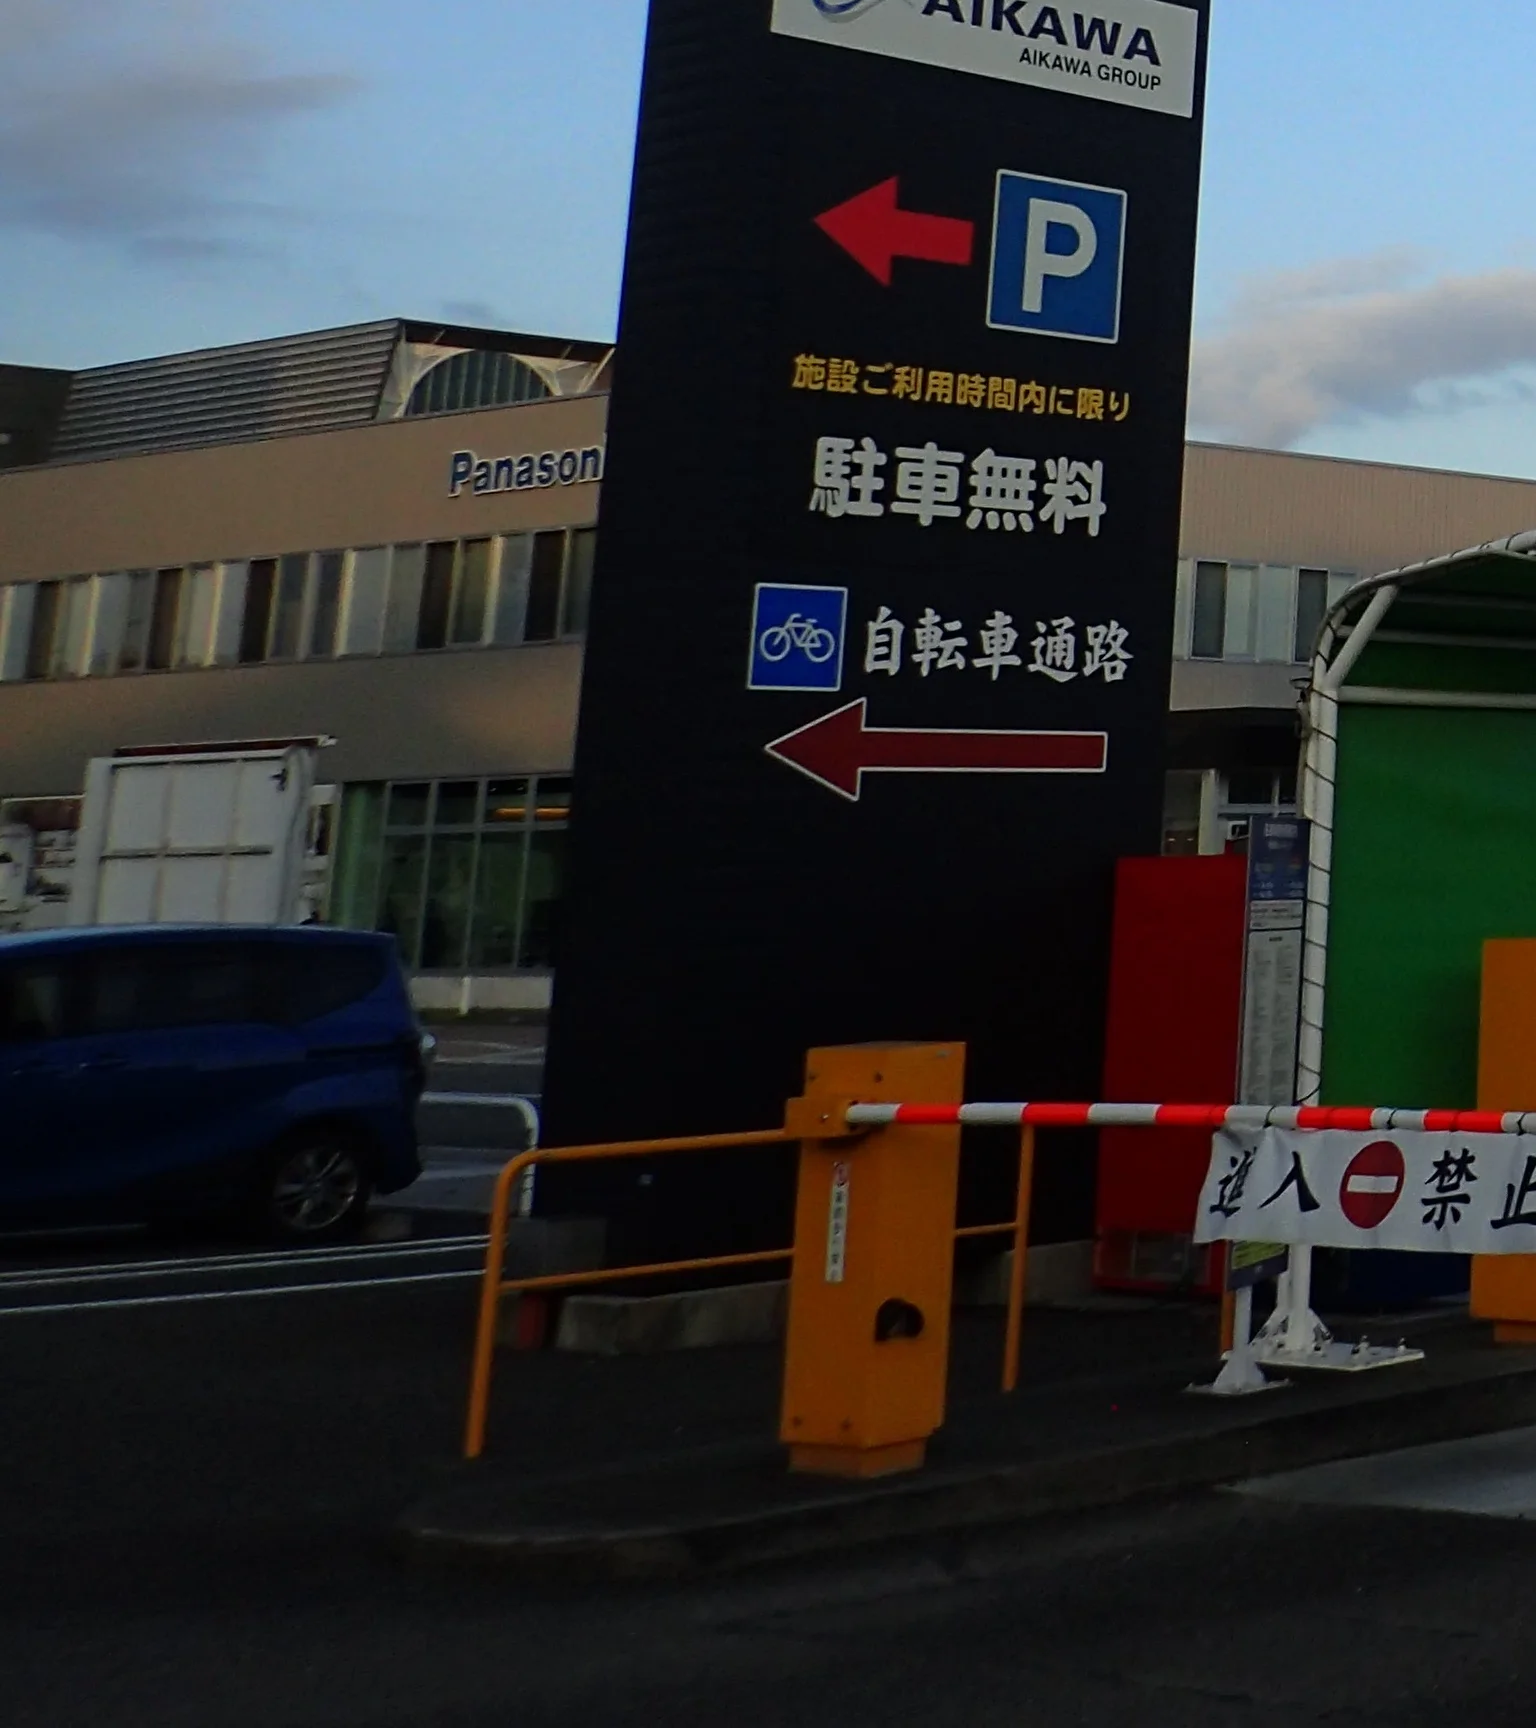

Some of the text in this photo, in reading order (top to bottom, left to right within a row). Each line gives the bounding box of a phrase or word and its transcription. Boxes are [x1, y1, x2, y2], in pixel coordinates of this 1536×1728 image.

[1018, 47, 1162, 91] AIKAWA GROUP
[1021, 196, 1098, 313] P
[790, 352, 1132, 423] 施設ご利用時間内に限り
[447, 445, 605, 498] Panason
[808, 433, 1107, 539] 駐車無料
[861, 604, 1135, 687] 自転車通路
[1208, 1145, 1321, 1219] 進入
